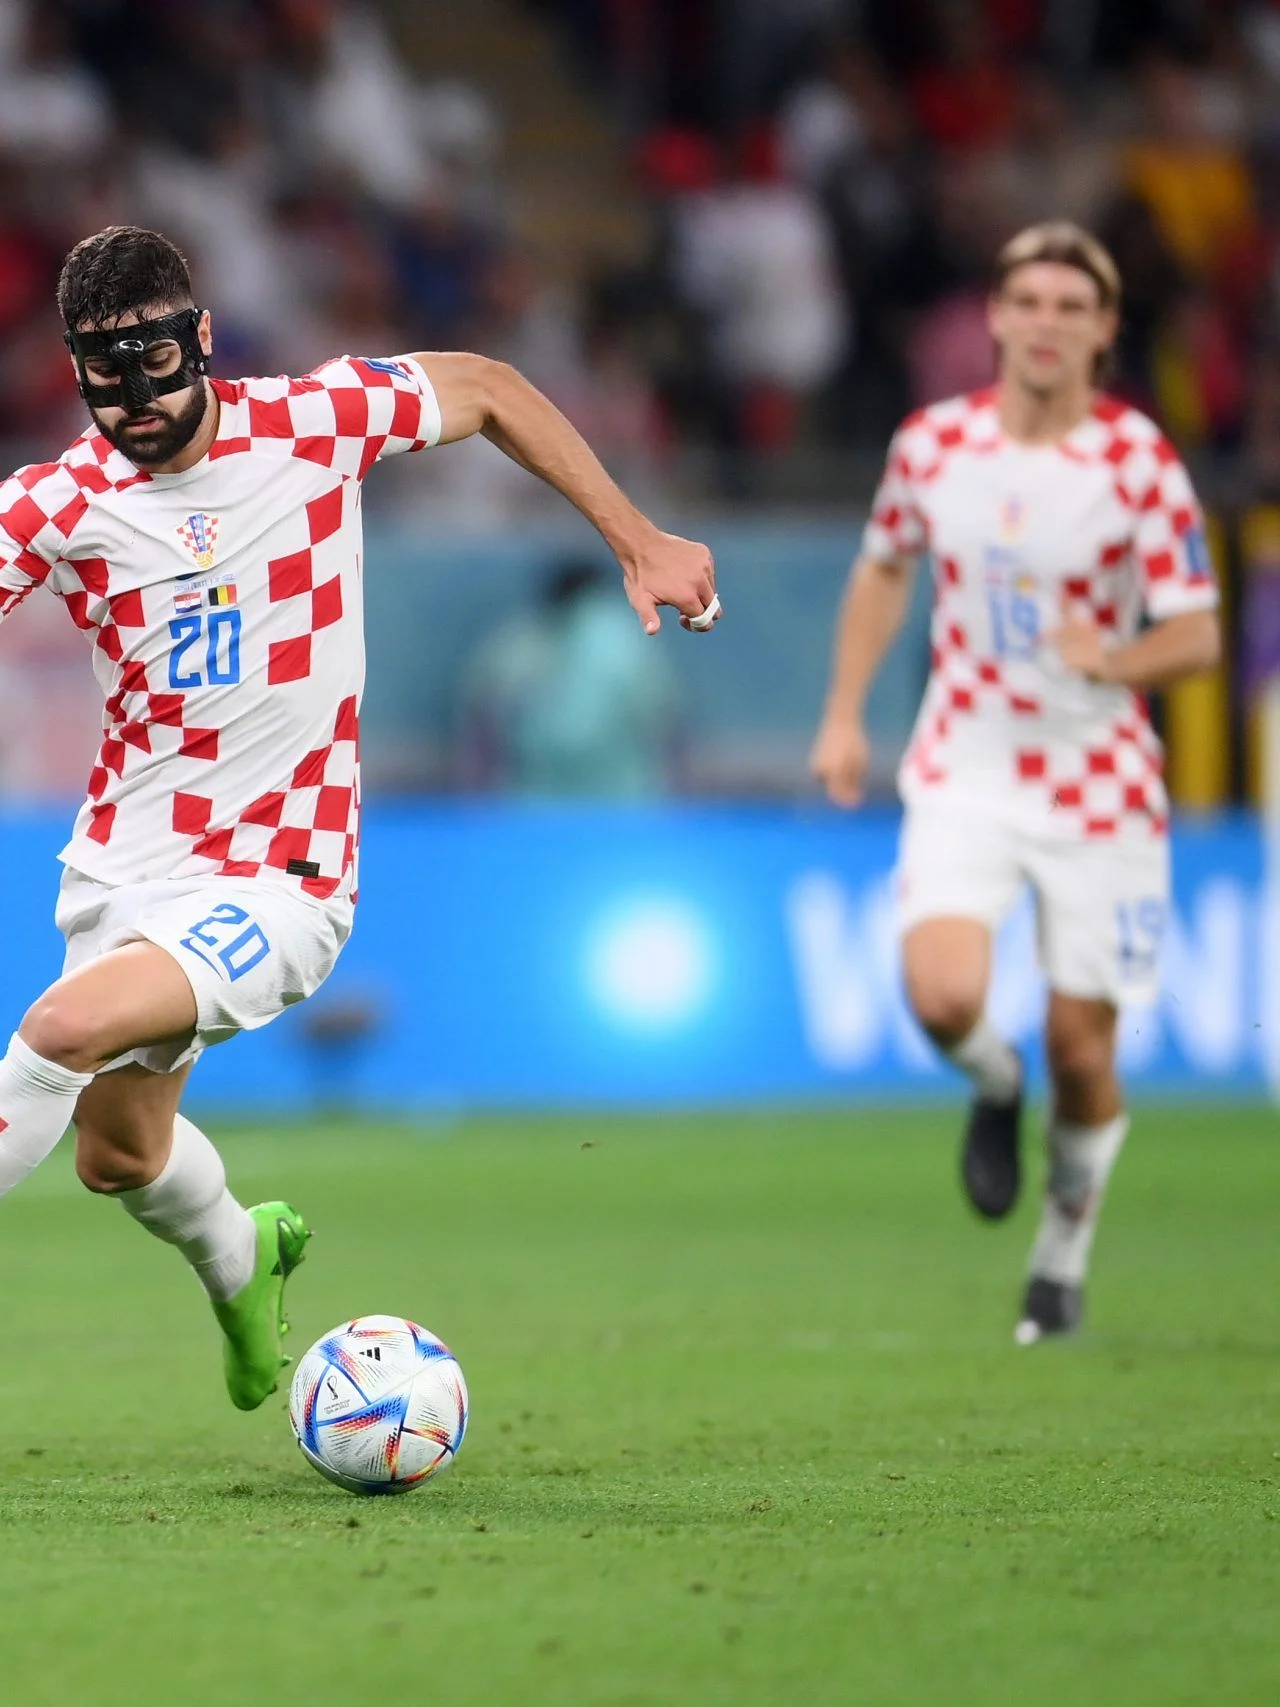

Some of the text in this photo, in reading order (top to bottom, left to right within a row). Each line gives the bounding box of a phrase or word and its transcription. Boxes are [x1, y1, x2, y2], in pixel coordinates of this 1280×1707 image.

[167, 609, 241, 689] 20
[986, 590, 1041, 661] 19
[188, 903, 271, 983] 20
